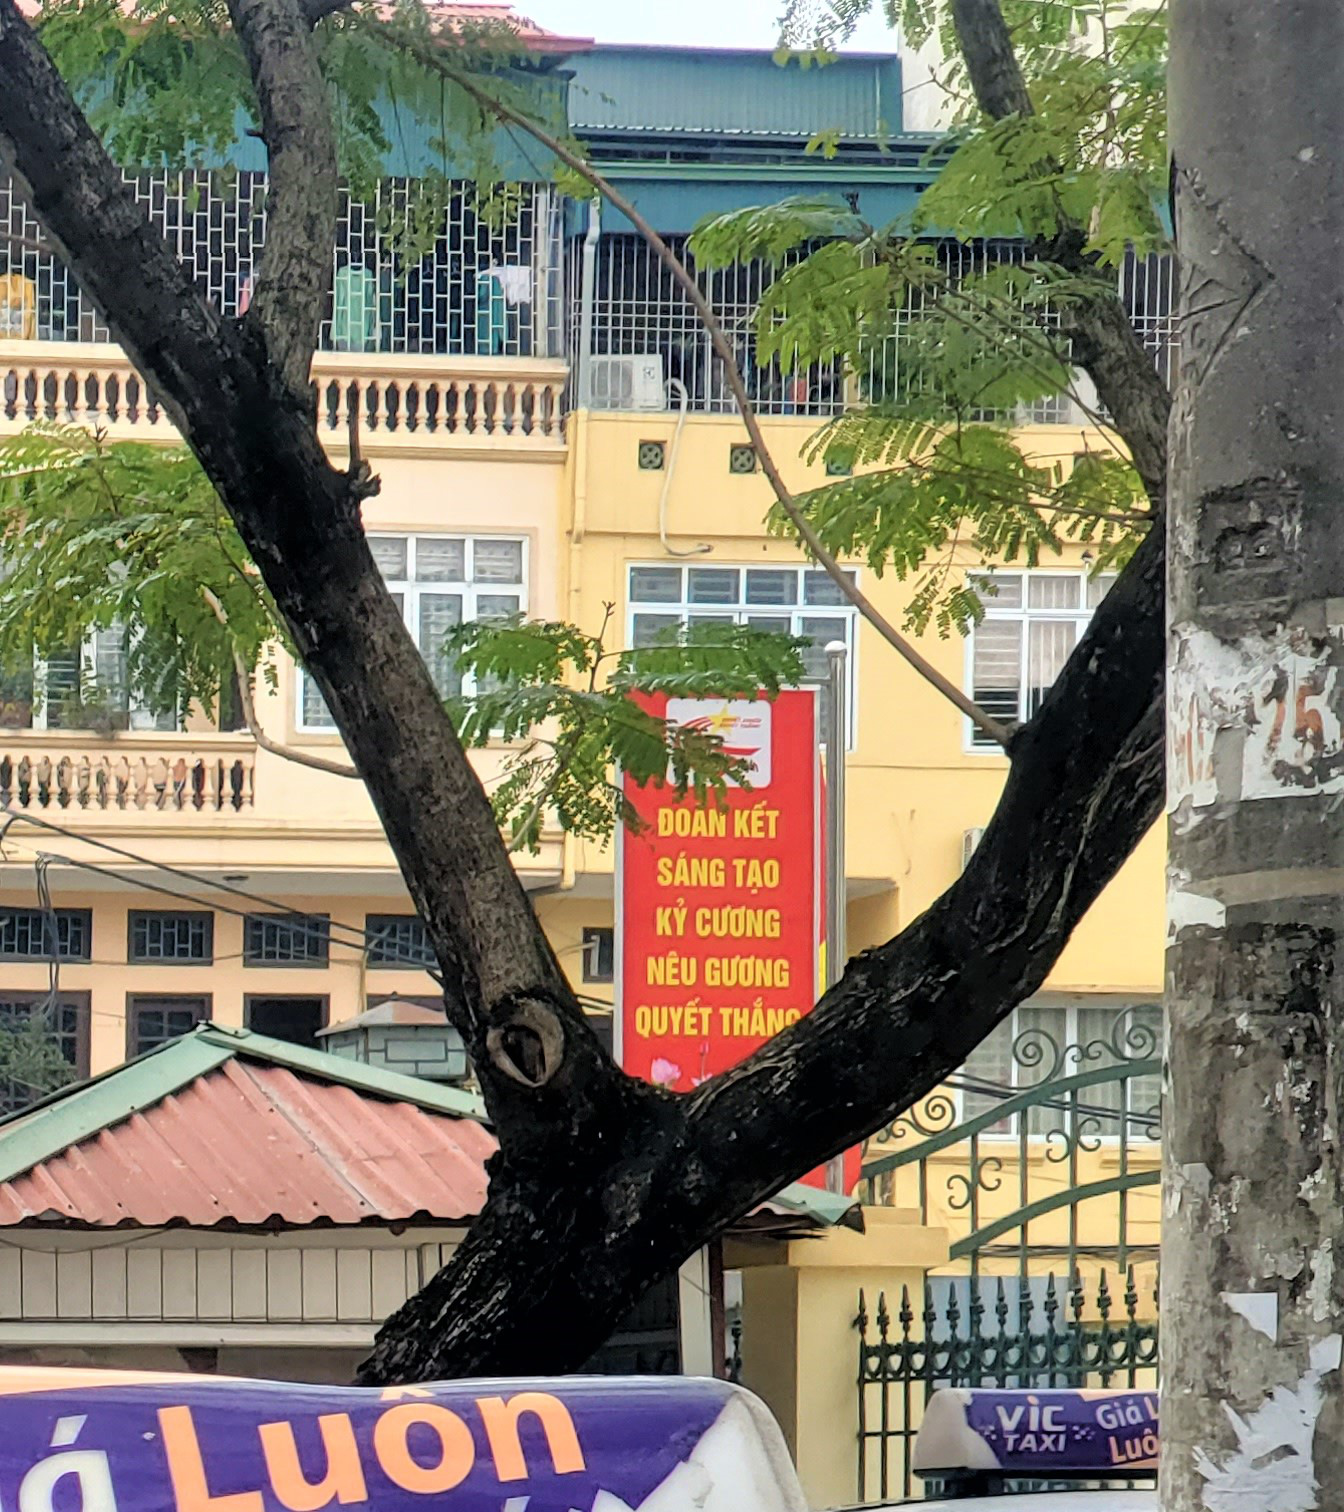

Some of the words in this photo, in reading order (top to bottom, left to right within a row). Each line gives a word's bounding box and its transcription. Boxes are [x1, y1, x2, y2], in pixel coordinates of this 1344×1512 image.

[734, 801, 780, 838] KẾT
[657, 851, 725, 888] SÁNG
[732, 859, 780, 894] TẠO
[656, 897, 687, 936] KỶ
[696, 905, 781, 937] CƯƠNG
[647, 951, 697, 985] NÊU
[705, 955, 789, 987] GƯƠNG
[635, 998, 712, 1037] QUYẾT
[1095, 1399, 1145, 1430] Giá
[1003, 1433, 1066, 1453] TAXI
[1109, 1428, 1160, 1463] Luô
